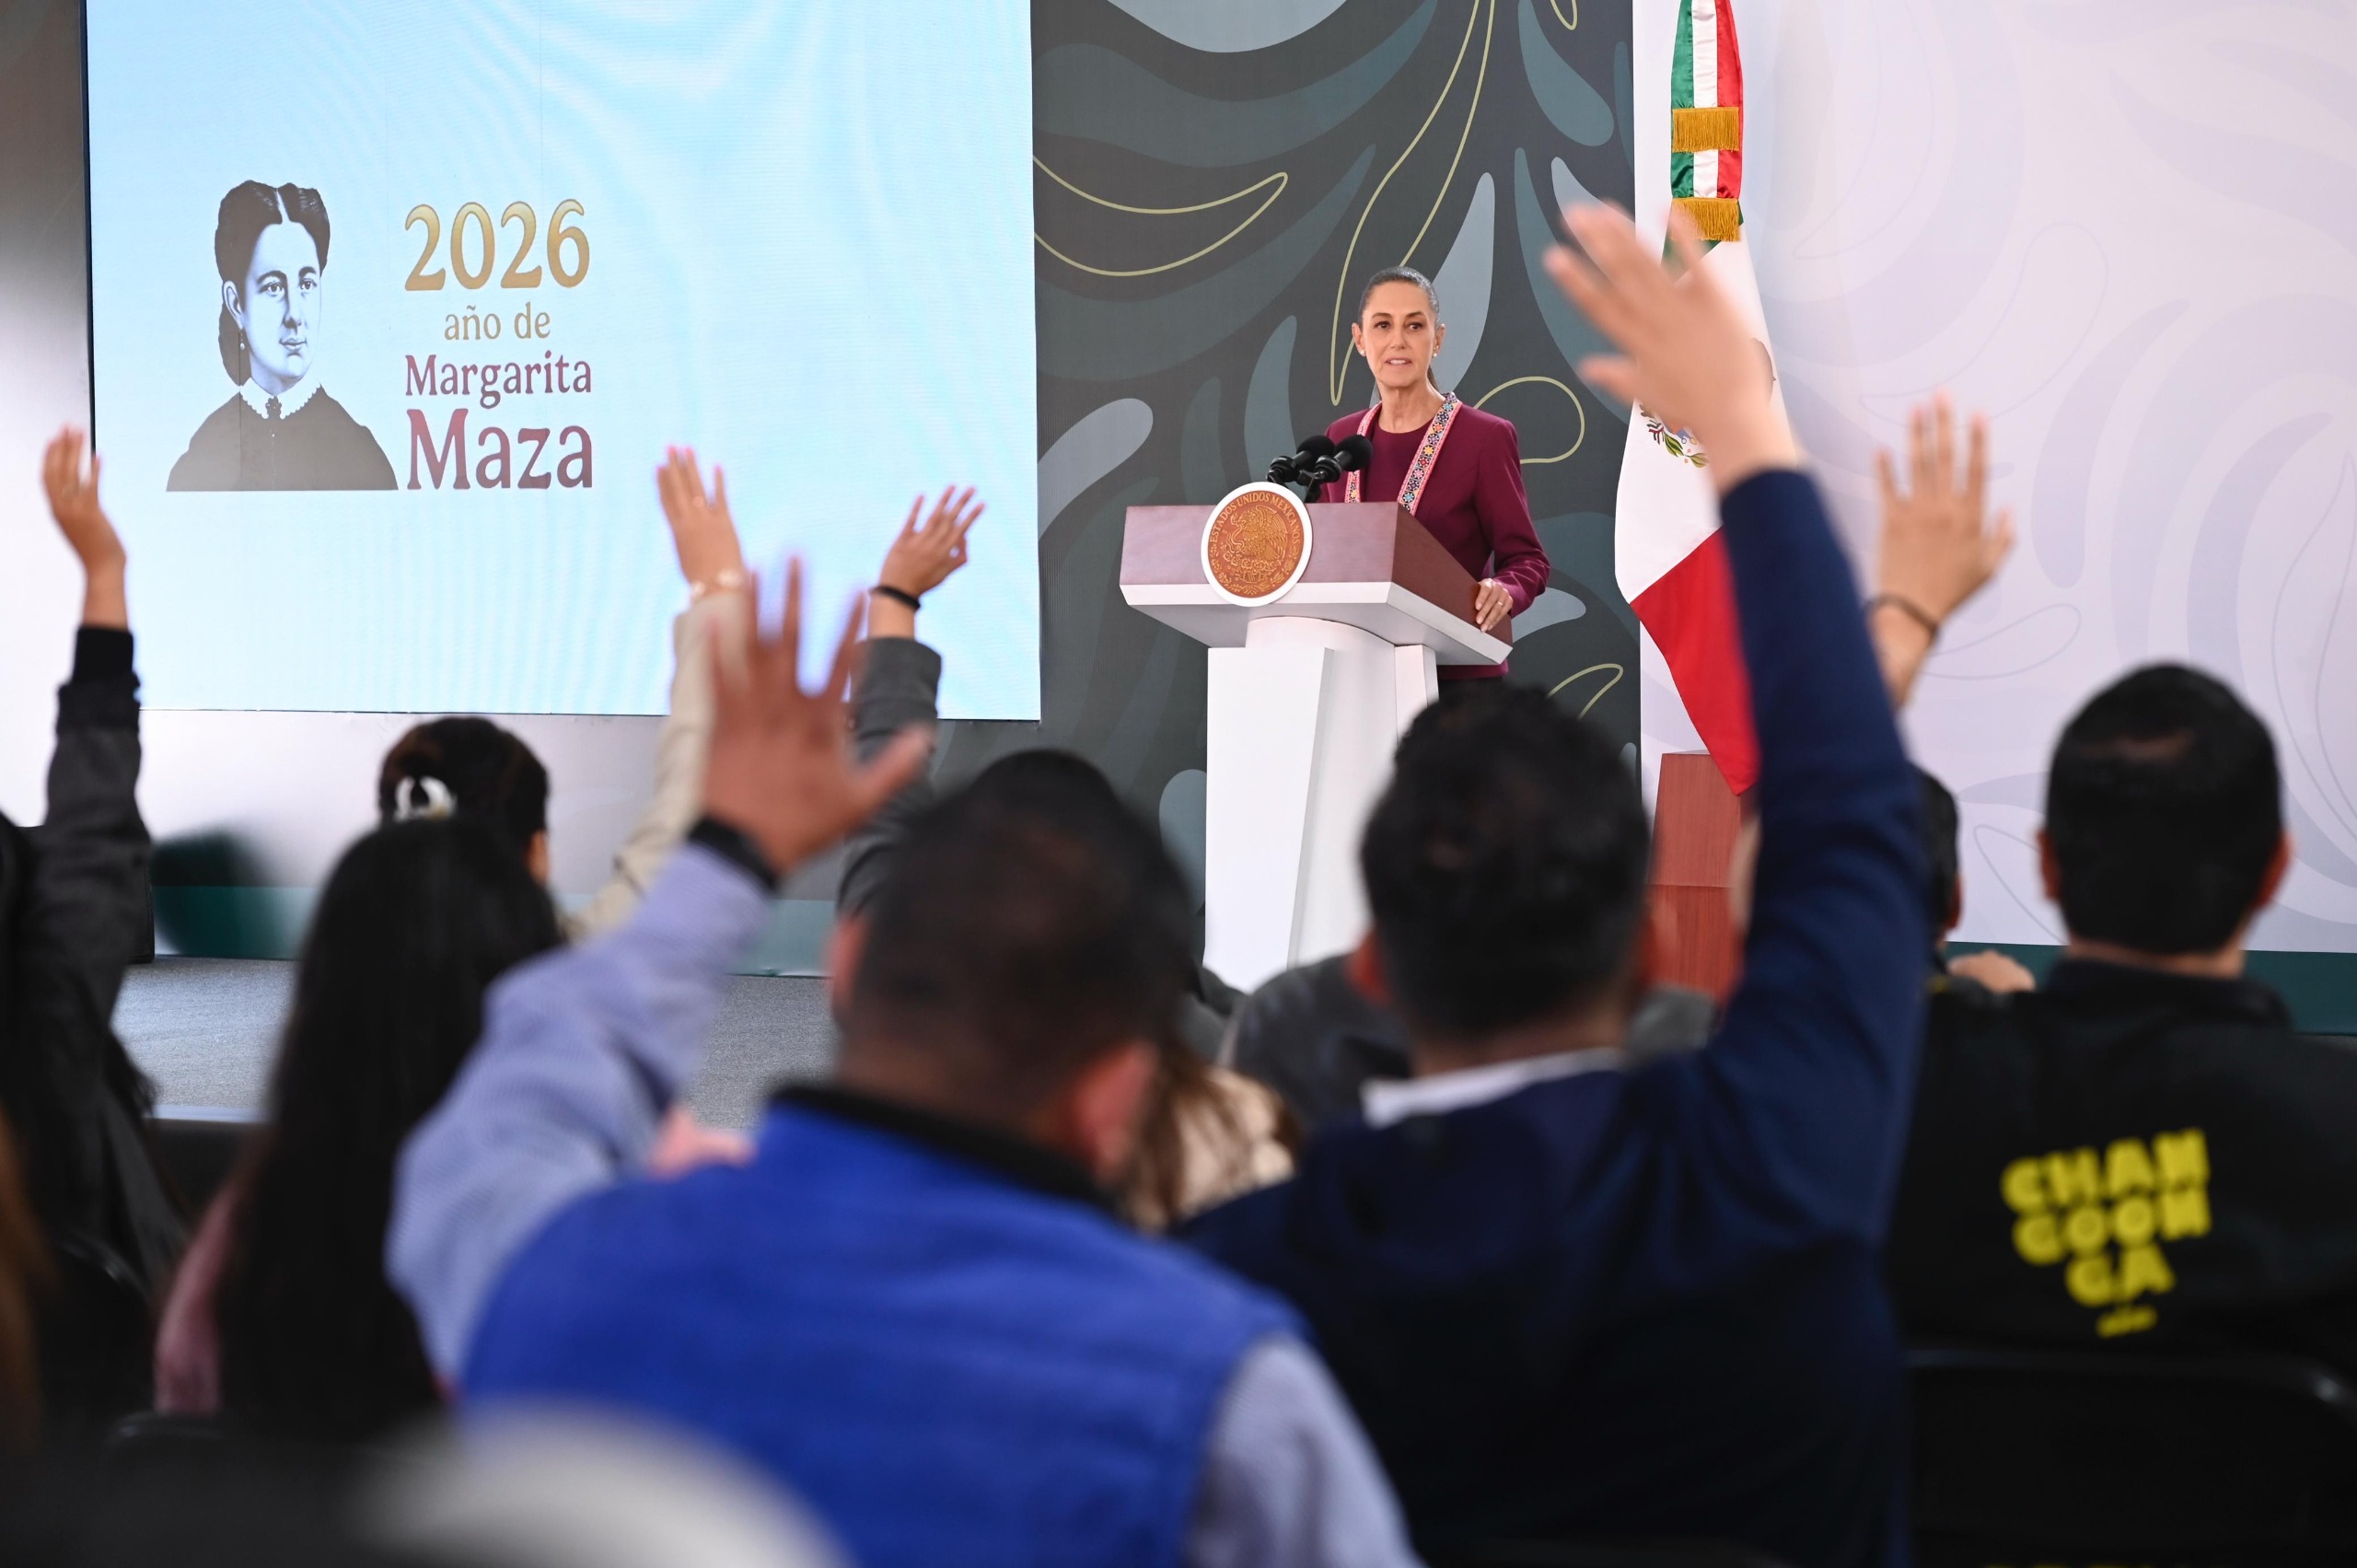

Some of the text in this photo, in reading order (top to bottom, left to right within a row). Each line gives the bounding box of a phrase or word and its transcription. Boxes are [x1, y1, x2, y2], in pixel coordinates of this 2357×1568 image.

[404, 199, 590, 291] 2026
[444, 301, 551, 341] año de
[405, 349, 592, 410] Margarita
[406, 407, 592, 490] Maza
[1210, 492, 1301, 545] ESTADOS UNIDOS MEXICANOS
